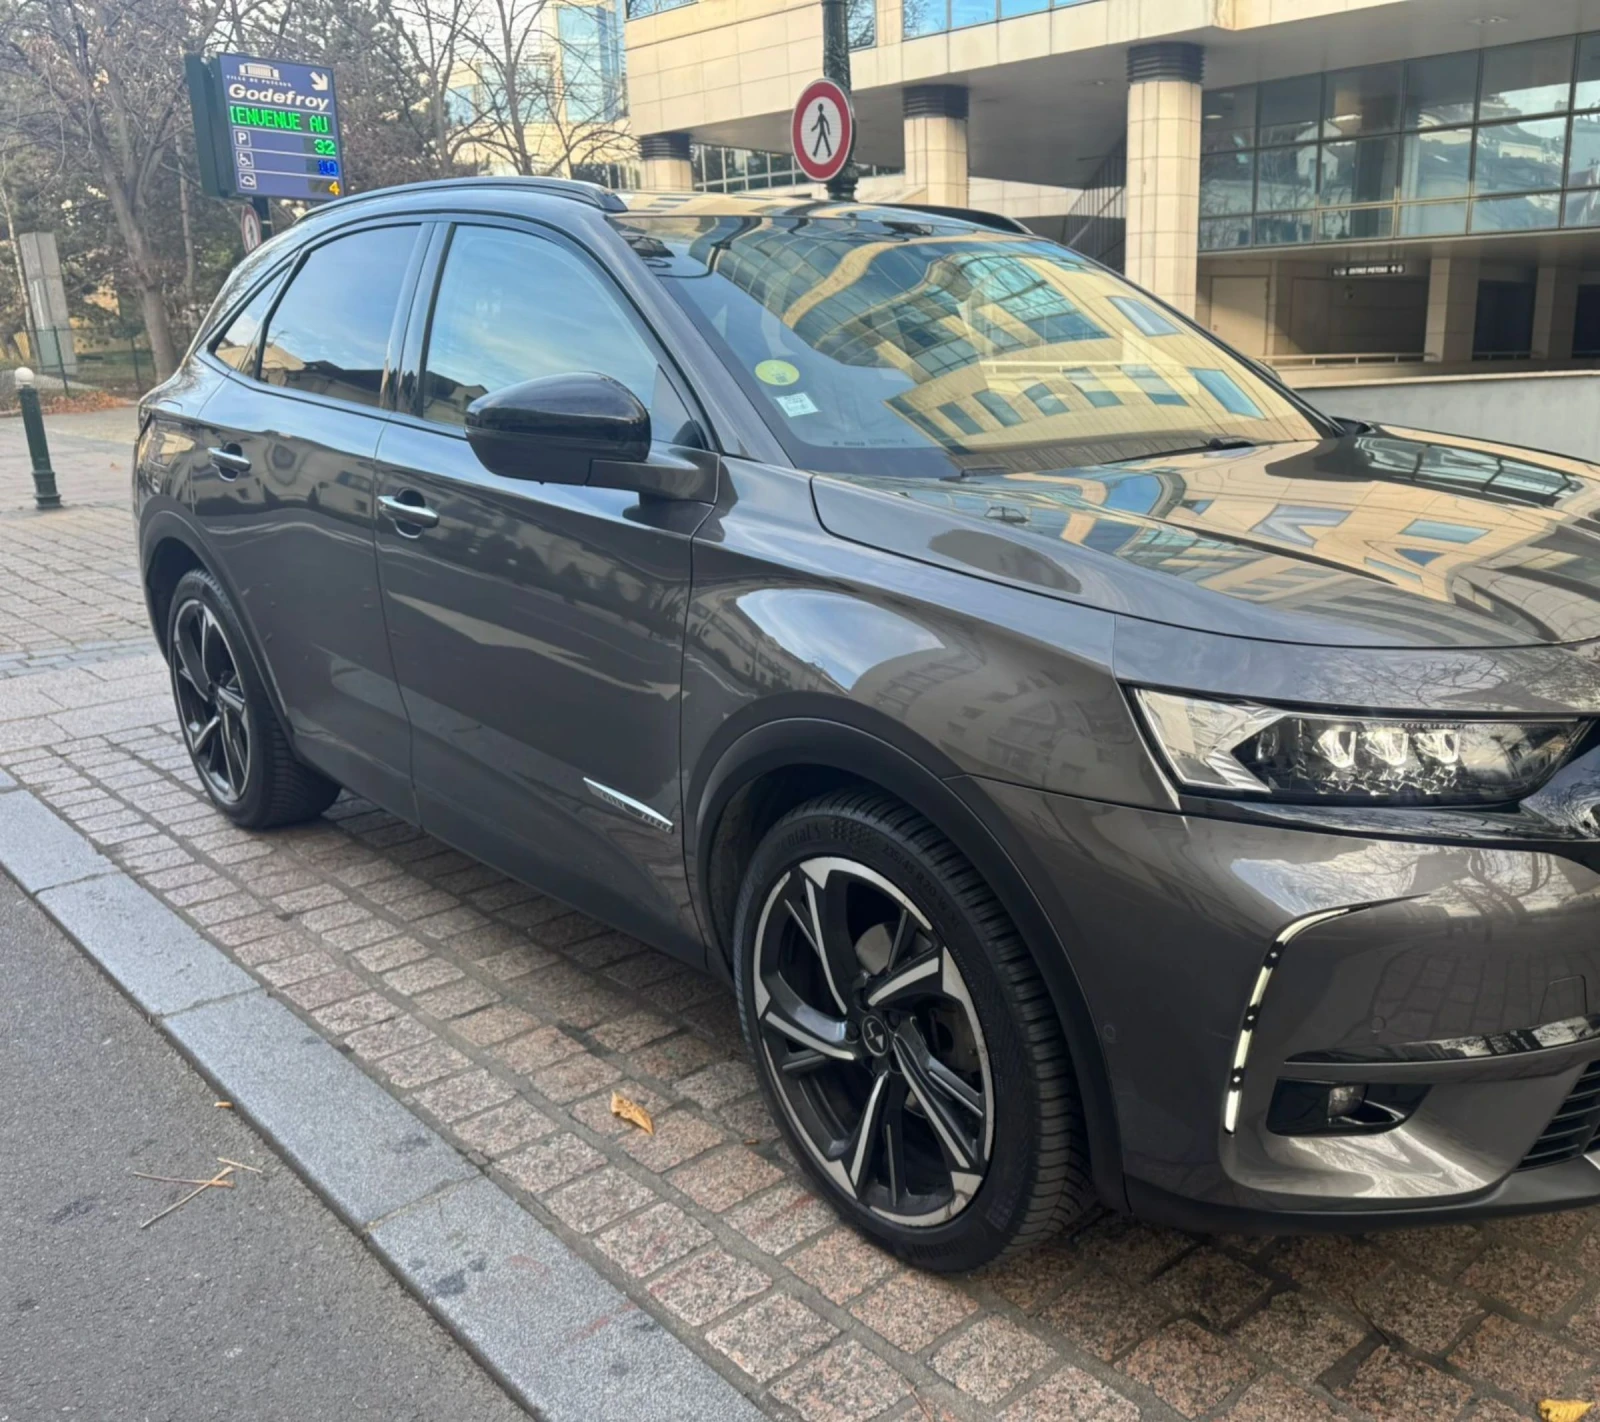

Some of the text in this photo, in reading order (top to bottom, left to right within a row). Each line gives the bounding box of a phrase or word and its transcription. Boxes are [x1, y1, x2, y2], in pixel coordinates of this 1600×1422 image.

[228, 83, 329, 111] Godefroy
[309, 115, 329, 133] AU
[237, 133, 247, 144] P
[314, 139, 336, 155] 32
[328, 181, 340, 196] 4
